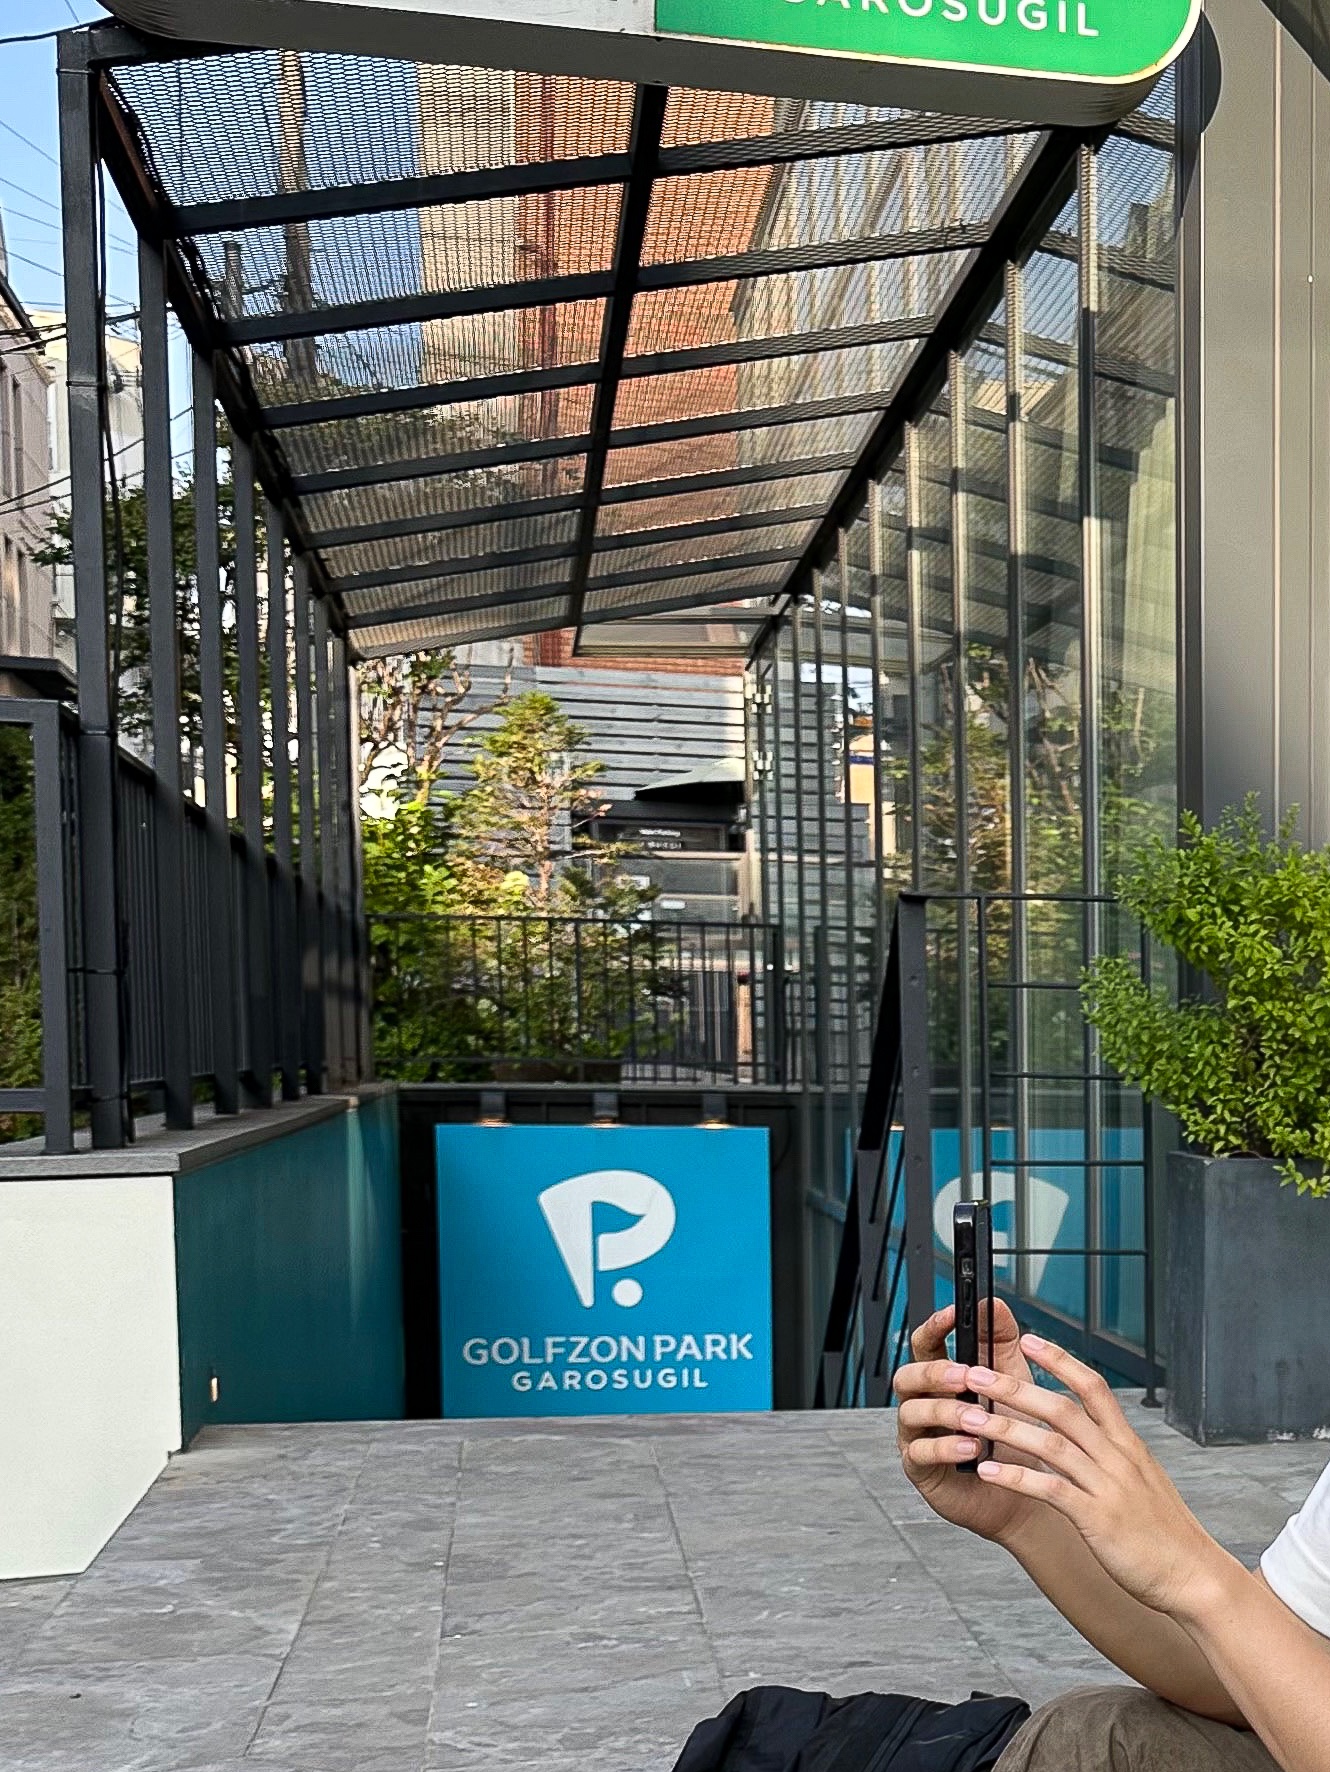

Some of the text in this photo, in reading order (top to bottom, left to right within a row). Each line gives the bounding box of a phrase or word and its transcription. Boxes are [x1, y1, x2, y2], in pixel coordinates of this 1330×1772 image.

[462, 1333, 754, 1366] GOLFZON PARK
[511, 1367, 709, 1392] GAROSUGIL
